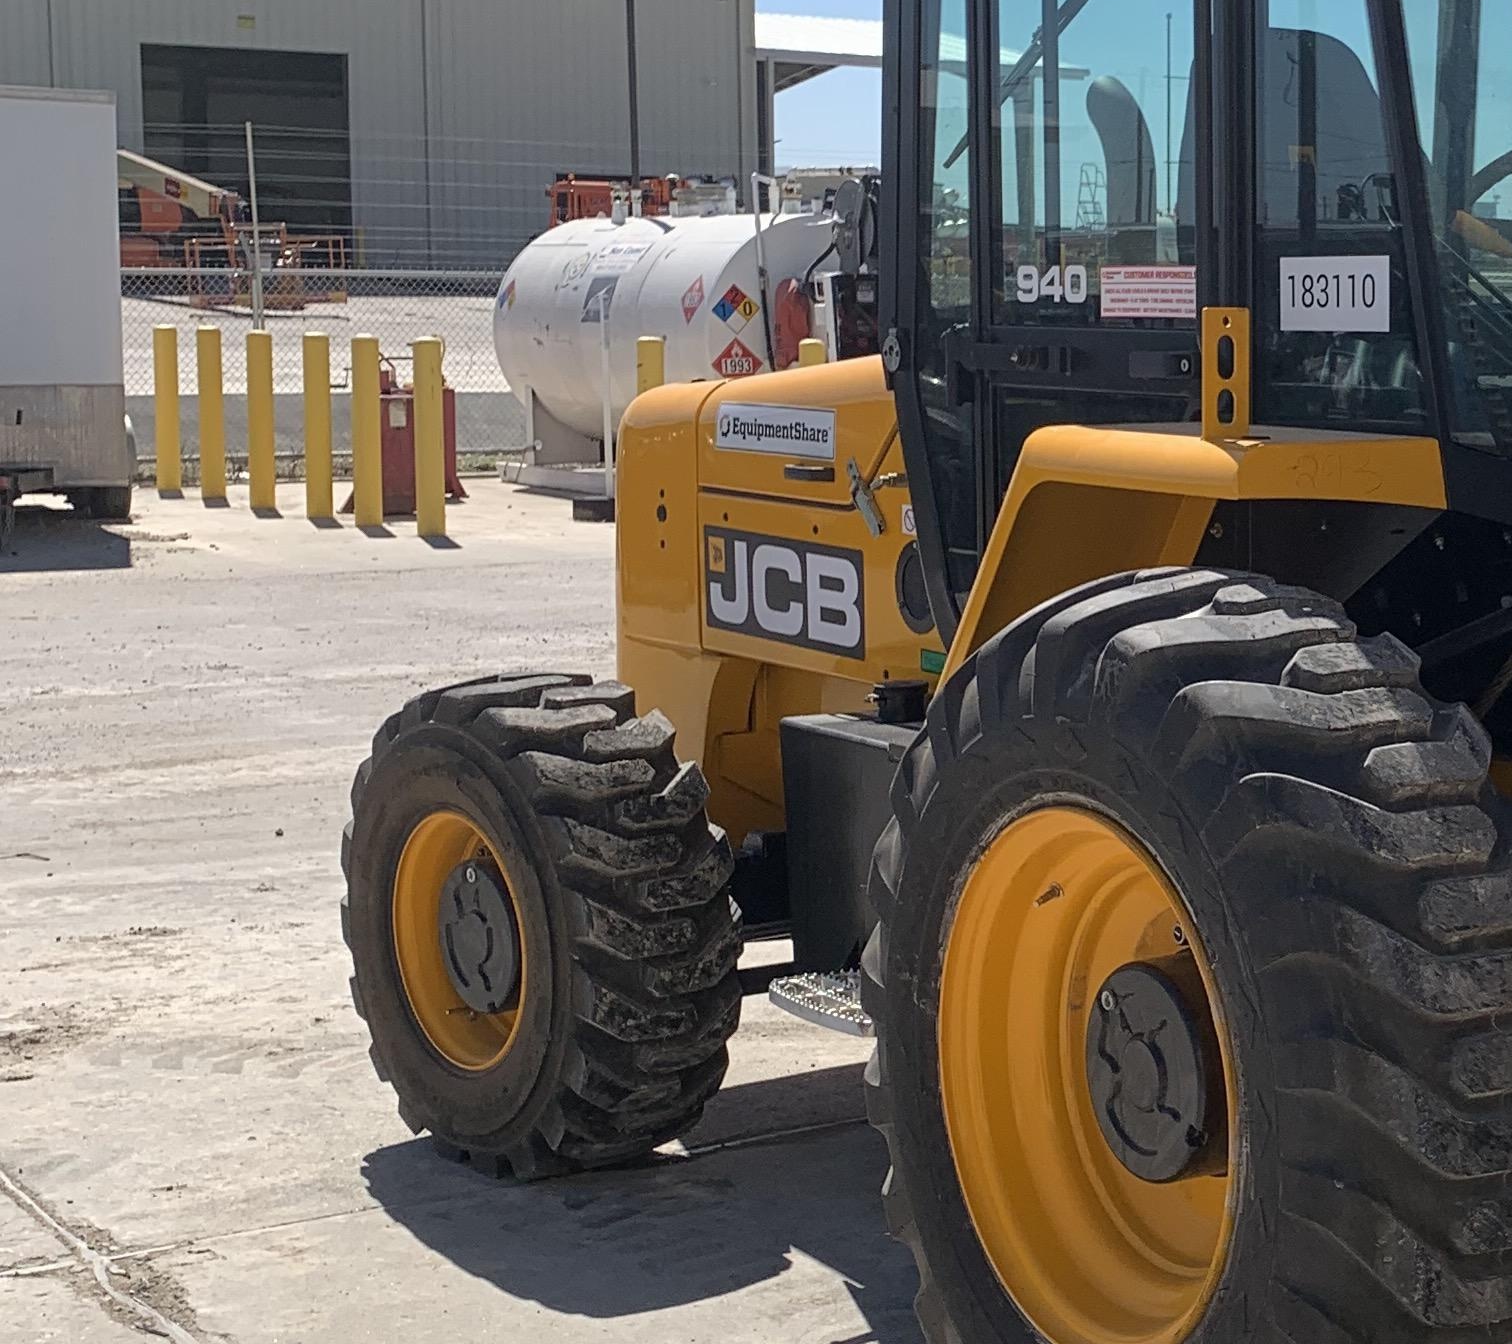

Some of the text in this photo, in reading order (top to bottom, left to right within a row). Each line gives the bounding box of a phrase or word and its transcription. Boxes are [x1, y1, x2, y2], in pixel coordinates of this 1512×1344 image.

[1016, 264, 1088, 304] 940
[1287, 273, 1376, 308] 183110
[743, 301, 753, 317] 0
[723, 358, 753, 373] 1993
[732, 417, 829, 443] EquipmentShare
[709, 540, 861, 648] JCB
